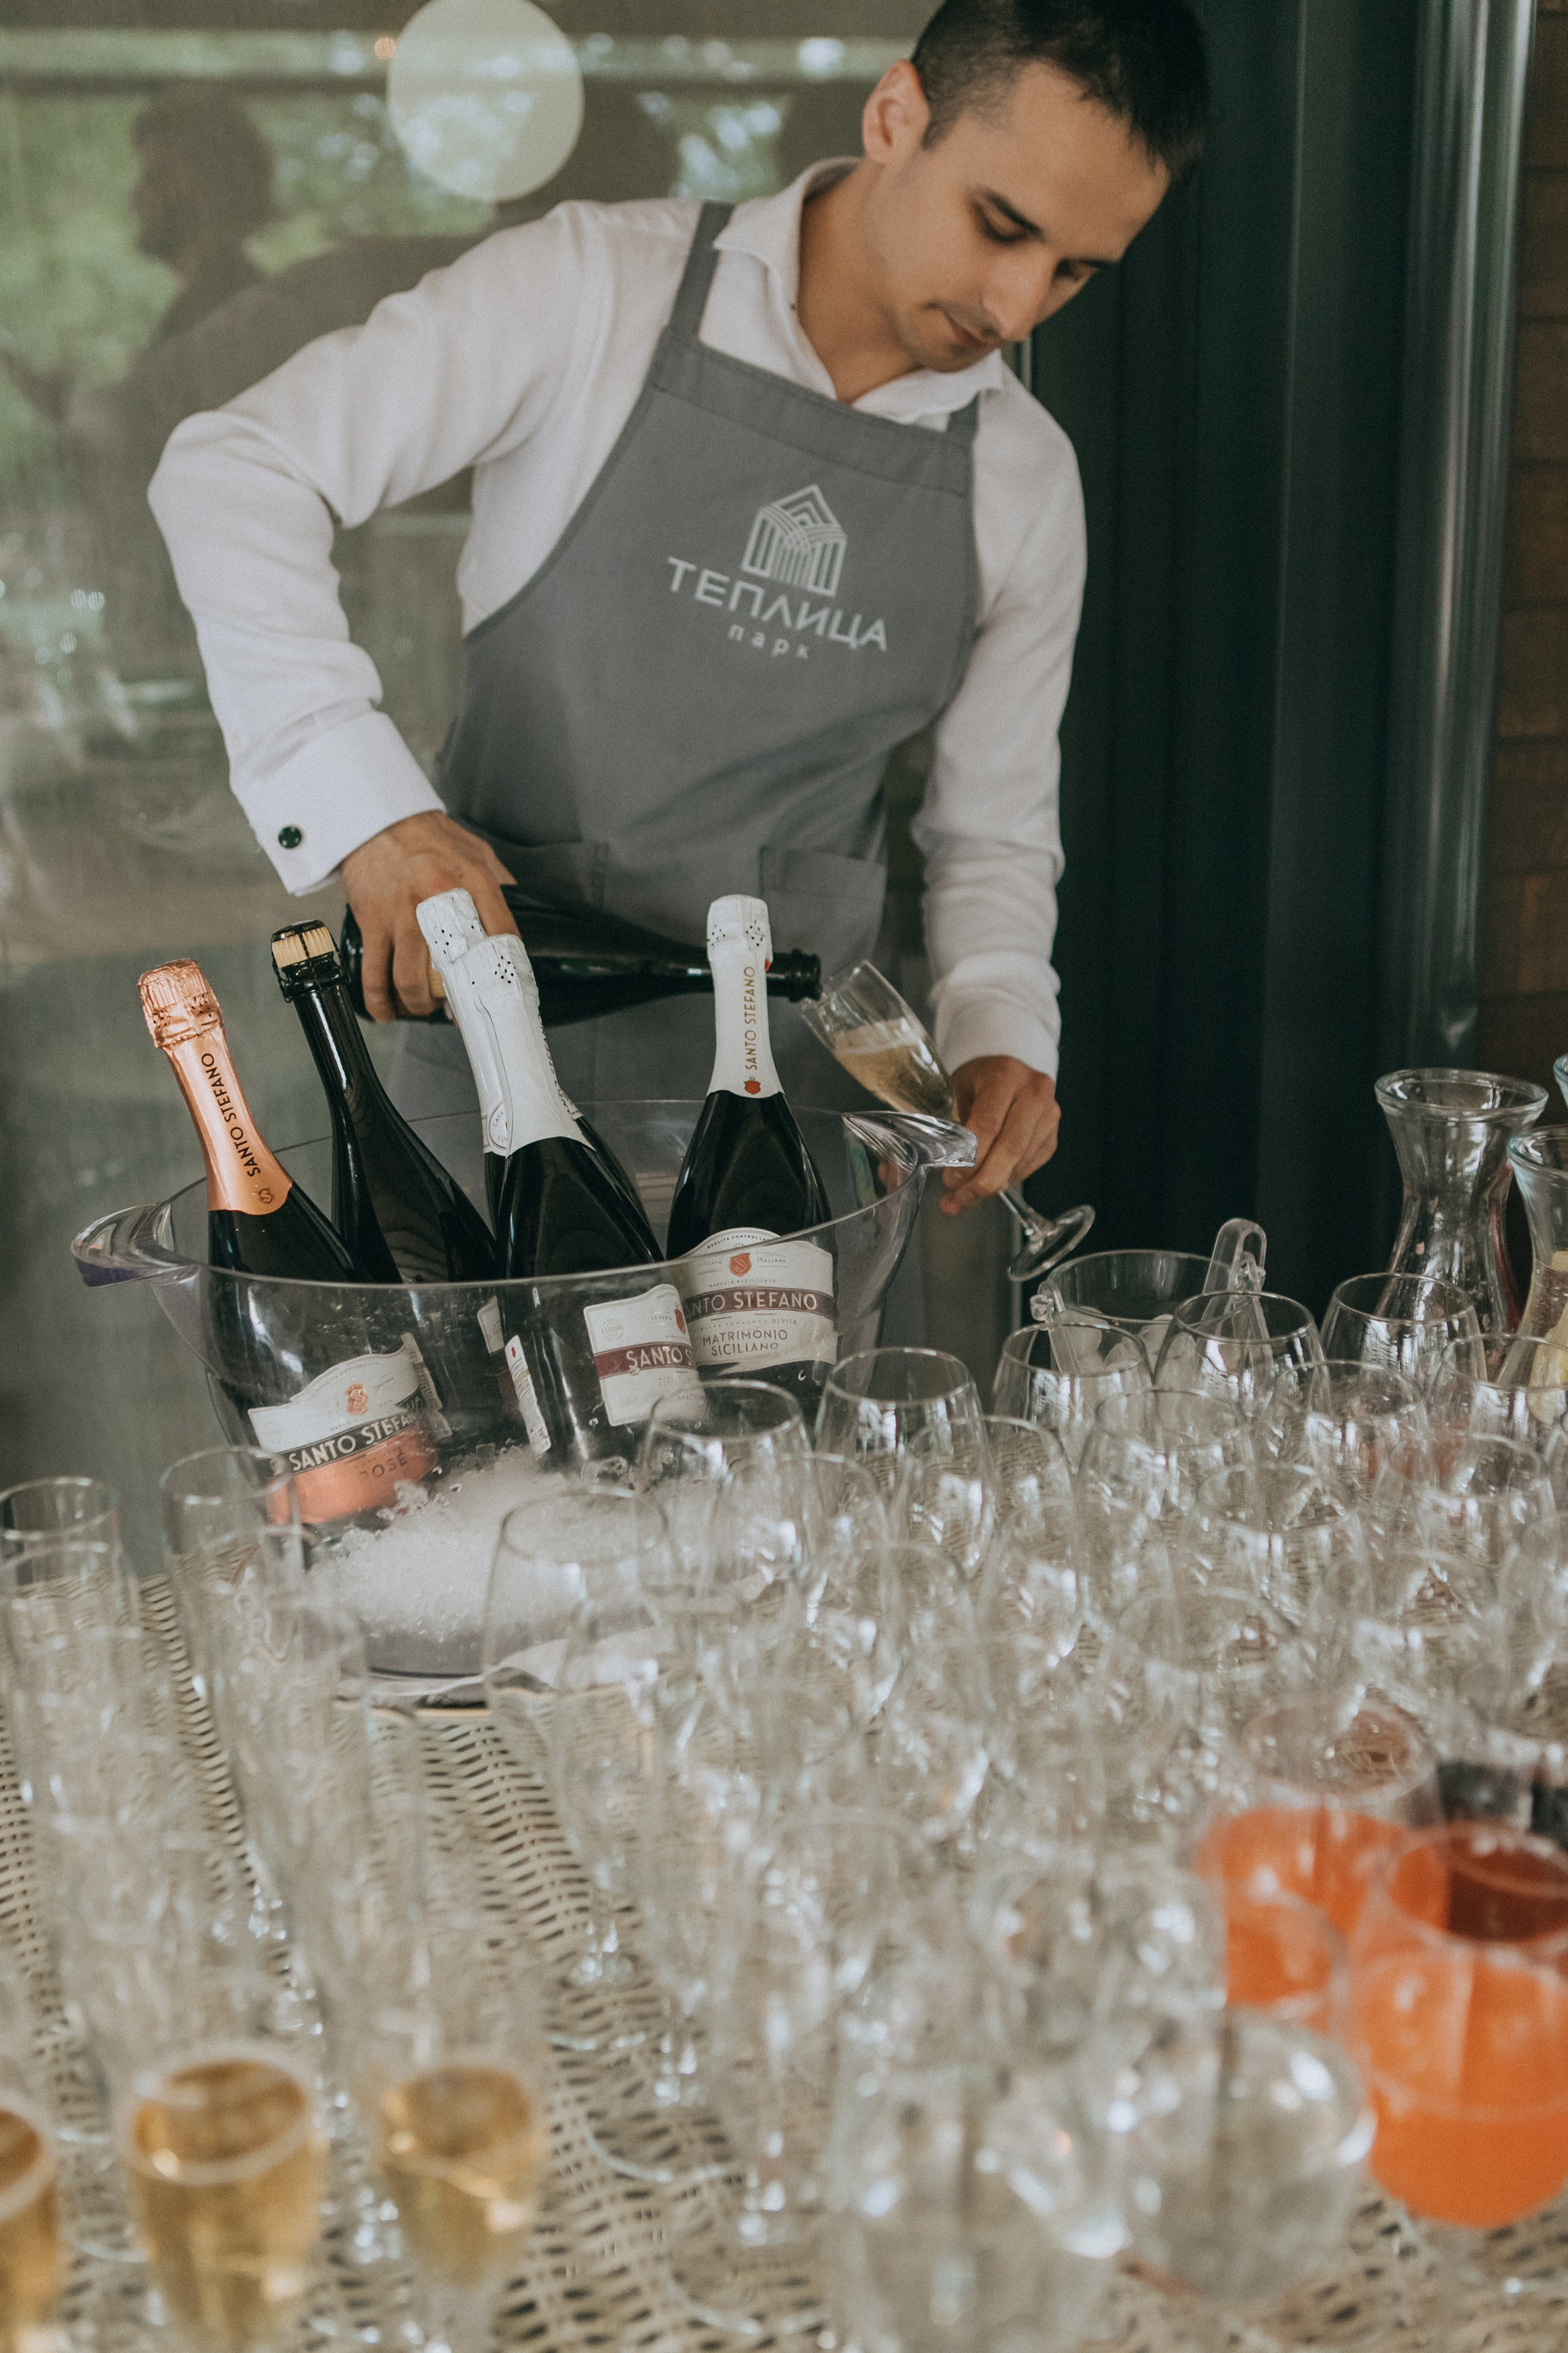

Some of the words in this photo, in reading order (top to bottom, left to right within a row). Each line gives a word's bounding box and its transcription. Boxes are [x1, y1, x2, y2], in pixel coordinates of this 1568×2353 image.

[668, 556, 887, 651] ТЕПЛИЦА
[728, 624, 810, 659] парк
[744, 966, 756, 1025] STEFANO
[745, 1030, 757, 1070] SANTO
[201, 1053, 237, 1123] STEFANO
[230, 1127, 261, 1177] SANTO
[733, 1291, 817, 1310] STEFANO
[703, 1329, 788, 1346] MATRIMONIO
[711, 1343, 778, 1356] SICILIANO
[626, 1346, 683, 1369] SANTO
[288, 1435, 356, 1471] SANTO
